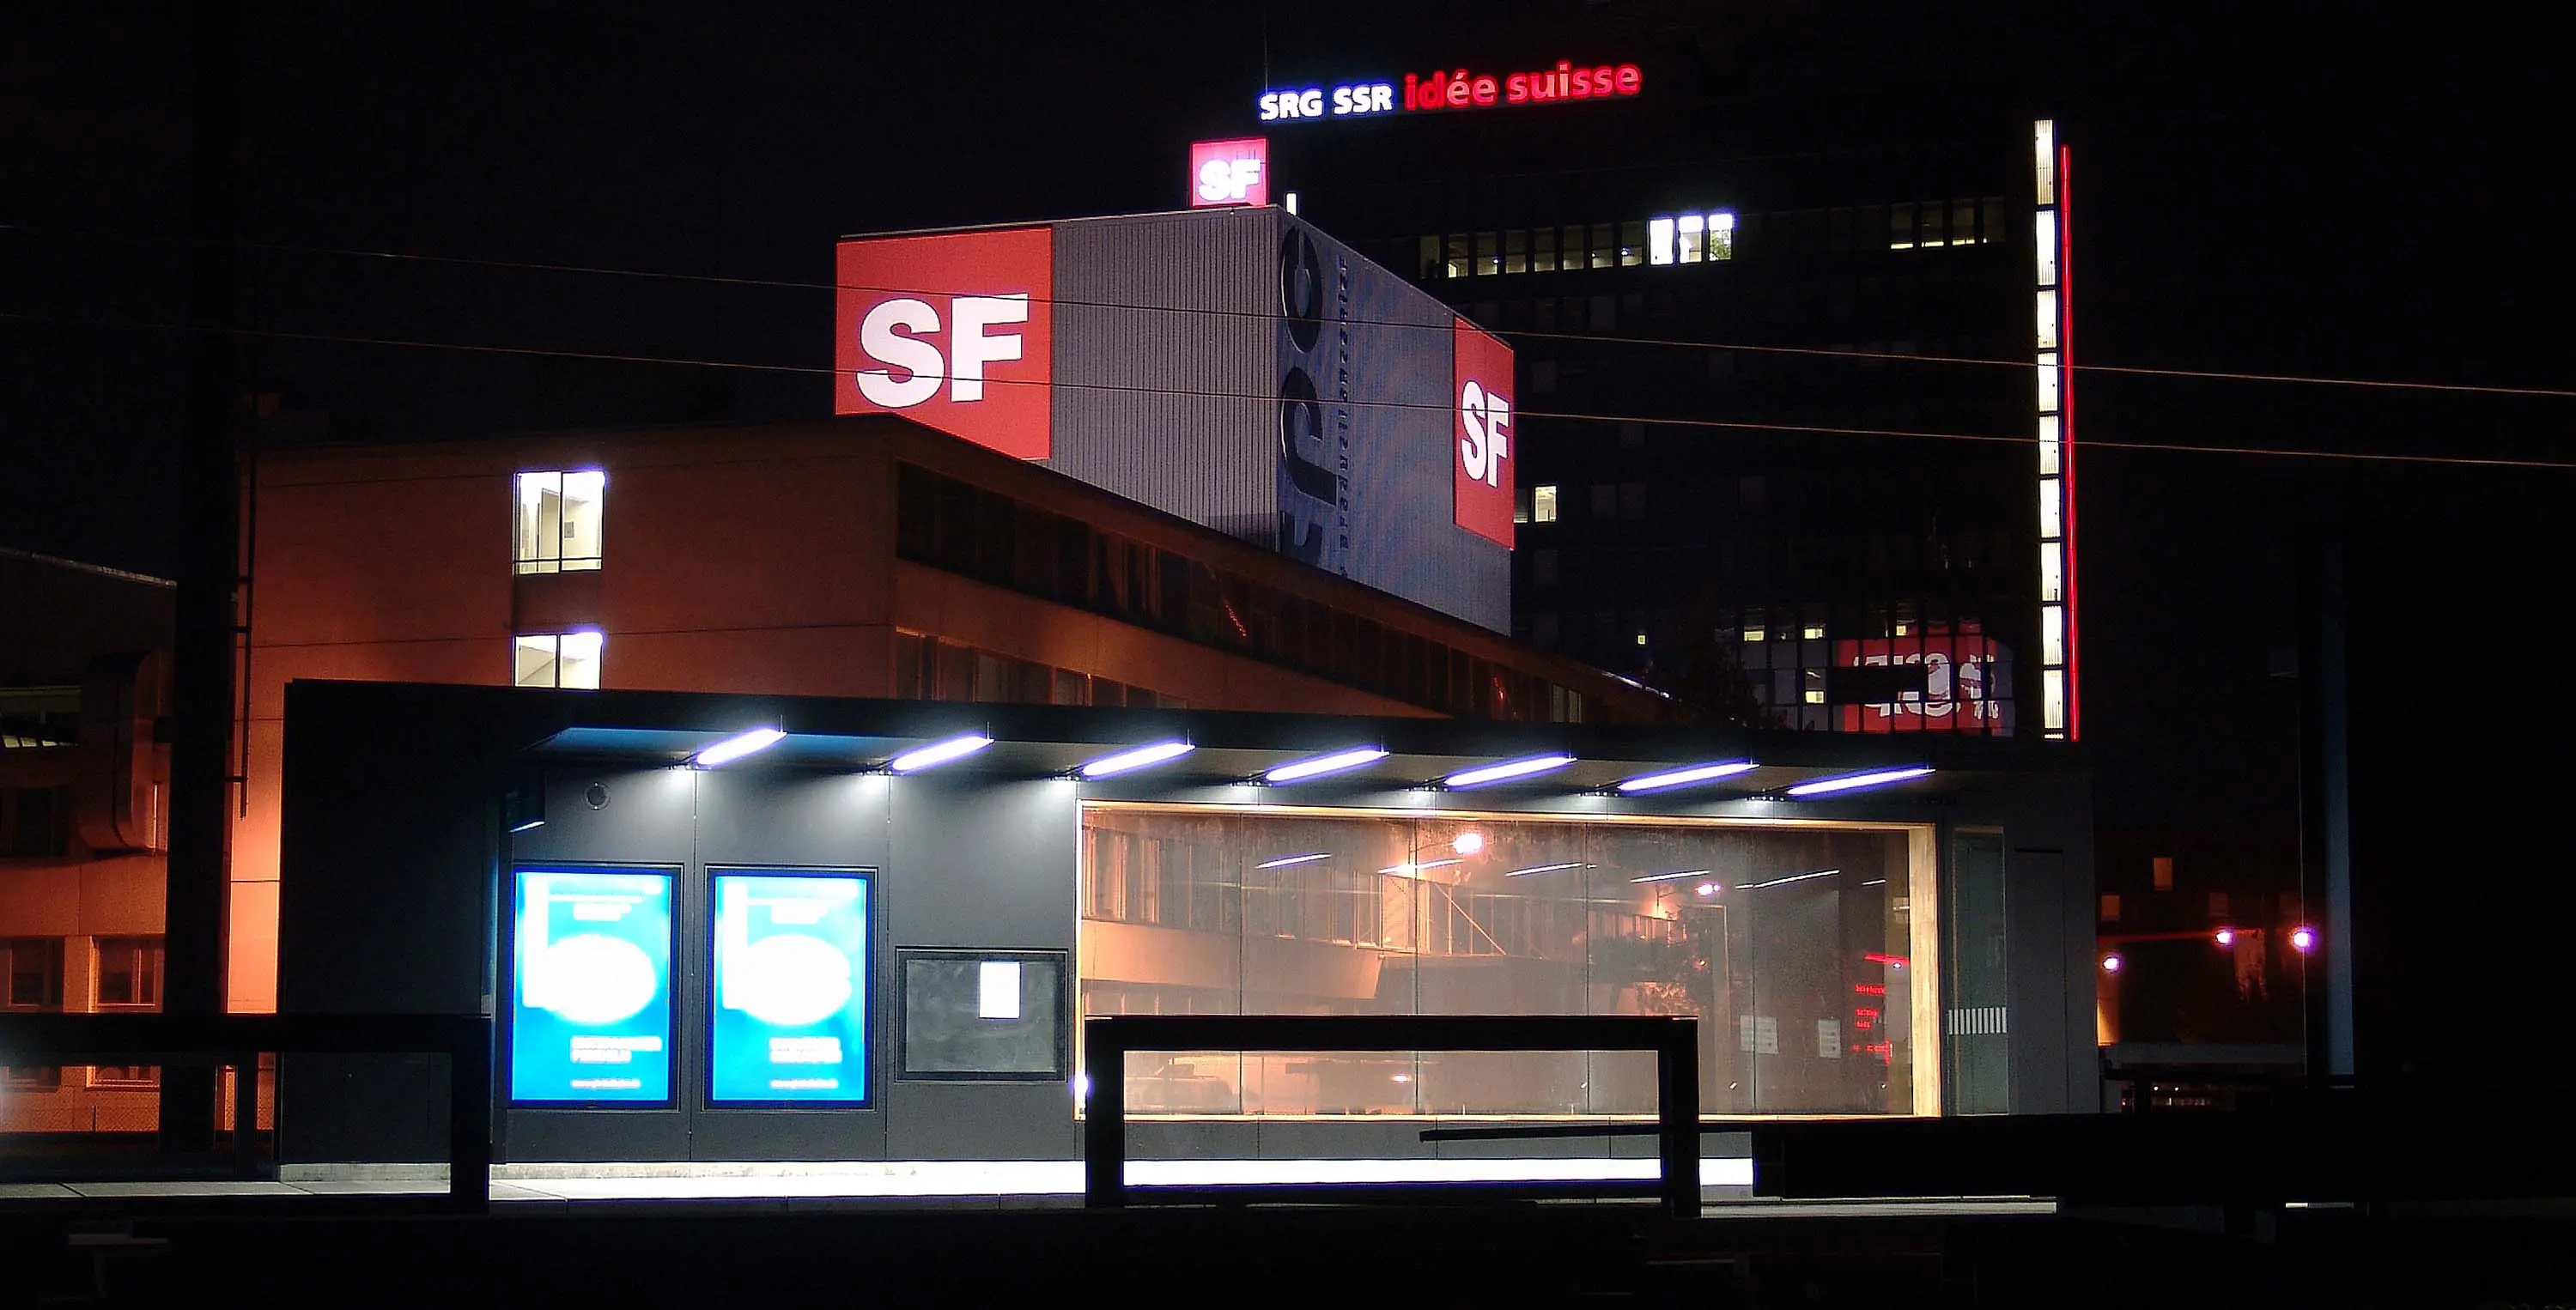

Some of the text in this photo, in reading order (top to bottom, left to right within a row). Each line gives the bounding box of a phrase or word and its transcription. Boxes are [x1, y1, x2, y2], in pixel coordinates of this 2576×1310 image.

[1259, 60, 1640, 120] SRG SSR idée suisse
[1199, 158, 1262, 201] SF
[856, 293, 1029, 408] SF
[1461, 379, 1510, 488] SF
